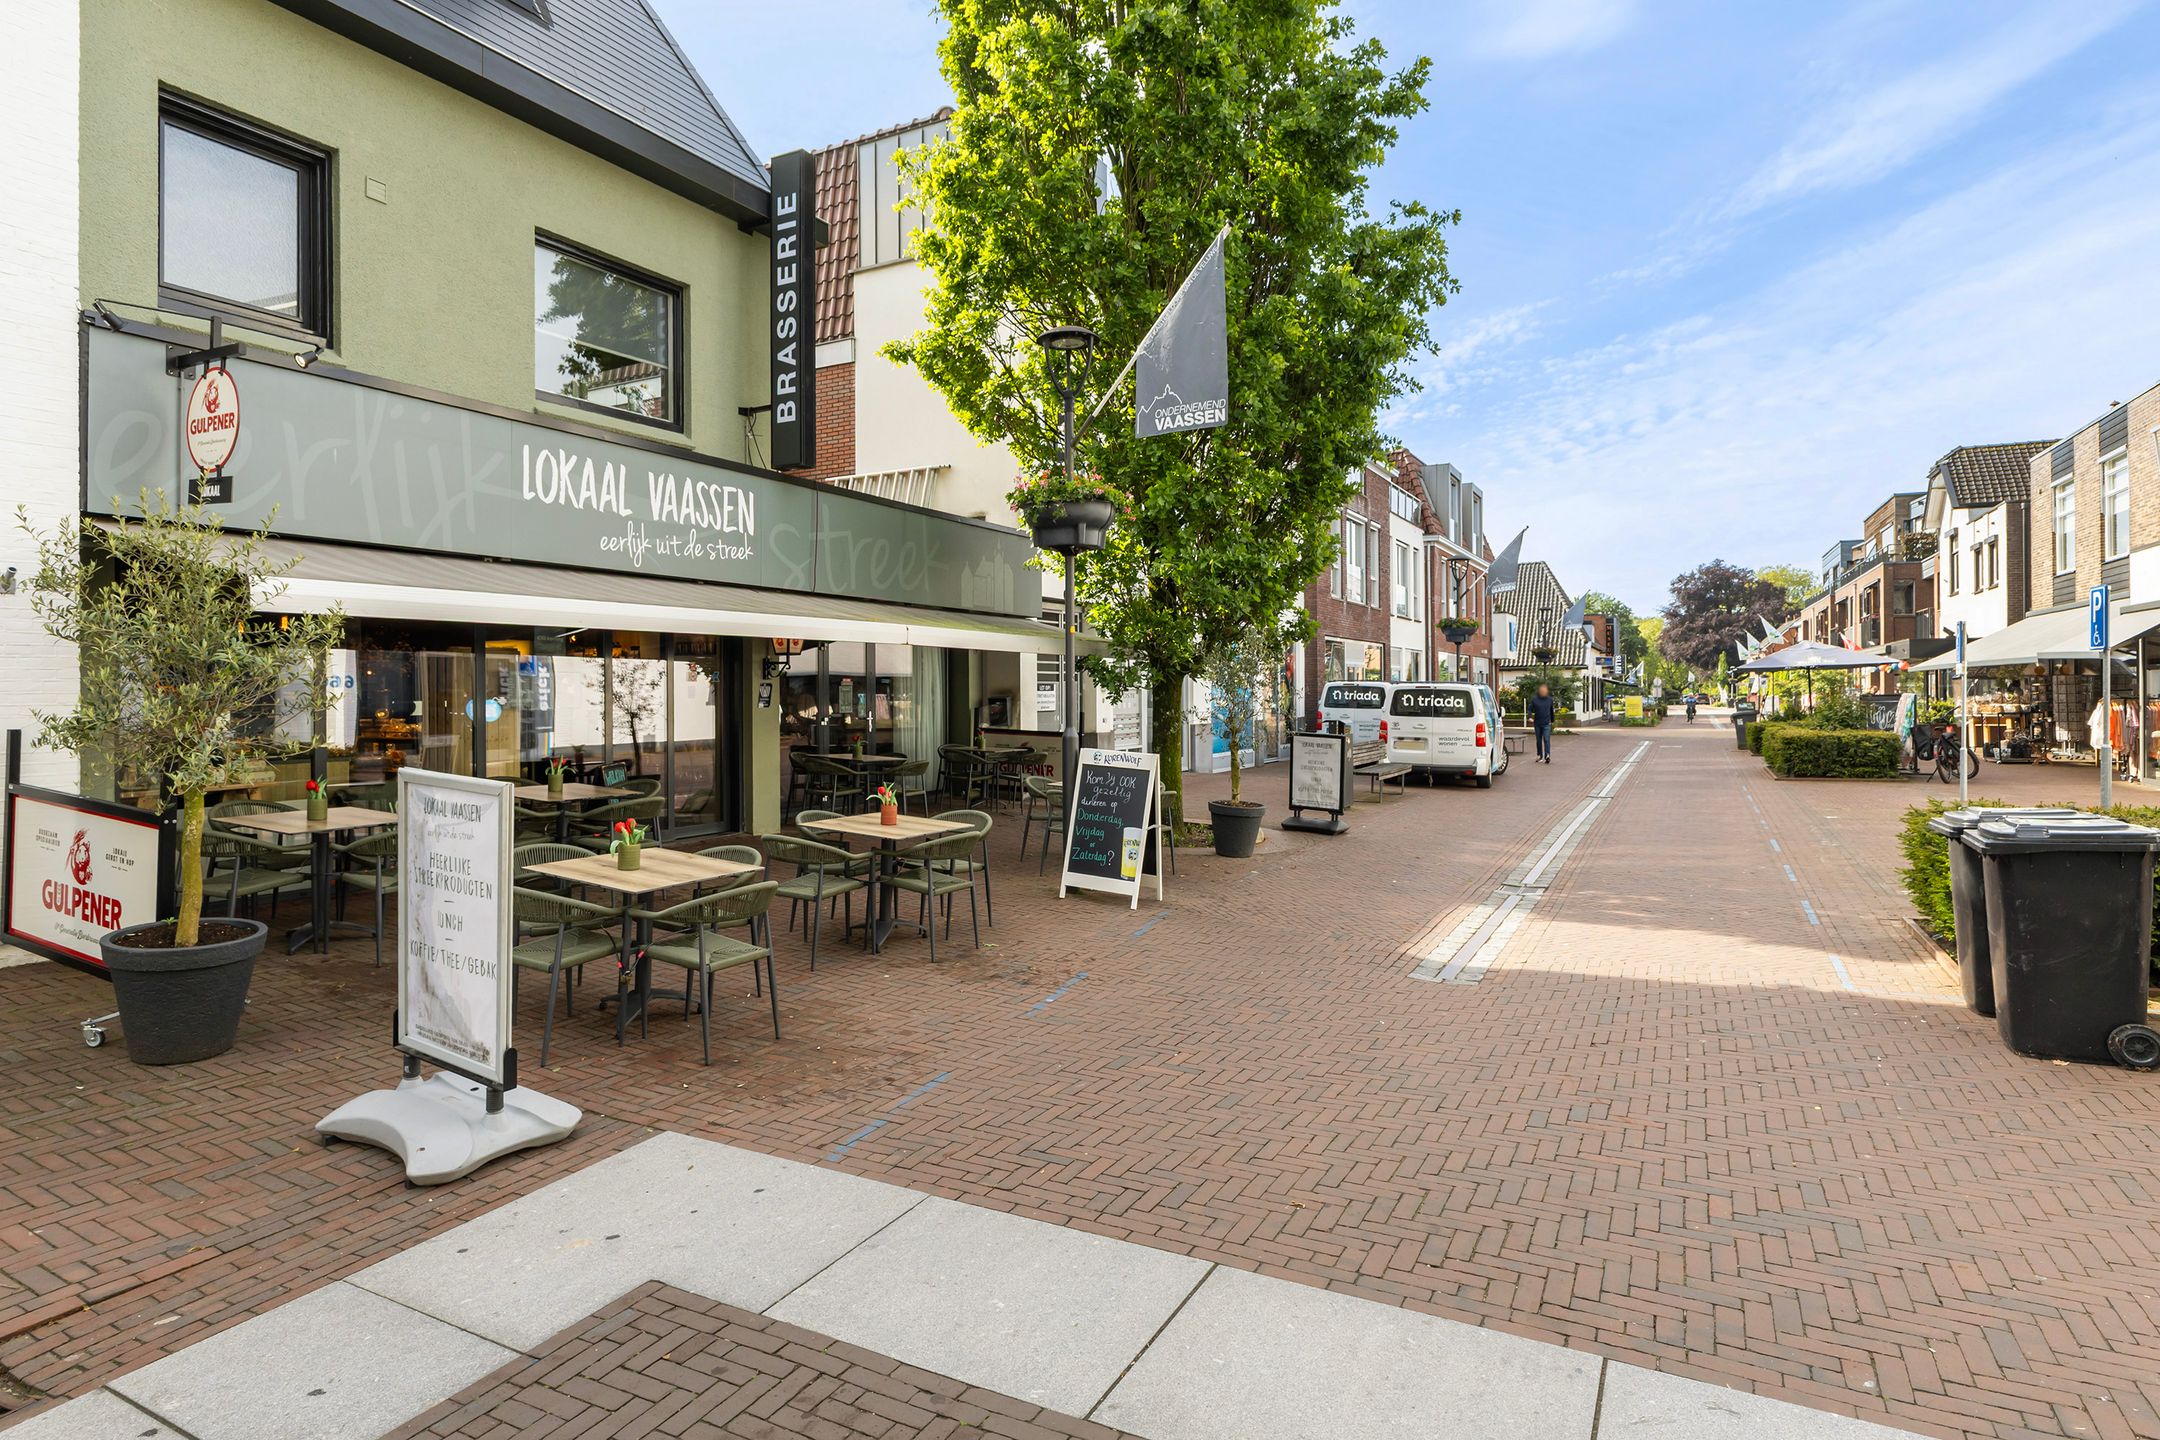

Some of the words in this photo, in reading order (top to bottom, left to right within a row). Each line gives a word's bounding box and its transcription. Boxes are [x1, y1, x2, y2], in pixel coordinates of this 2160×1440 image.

[776, 191, 797, 425] BRASSERIE
[1154, 398, 1226, 418] ONDERNEMEND
[1154, 408, 1226, 431] VAASSEN
[190, 411, 235, 435] GULPENER
[522, 444, 633, 518] LOKAAL
[648, 471, 755, 536] VAASSEN
[599, 520, 652, 568] eerlijk
[656, 535, 683, 558] uit
[683, 528, 704, 560] de
[706, 532, 754, 561] streek
[768, 503, 949, 595] streek
[2092, 591, 2102, 623] P
[1343, 690, 1380, 701] triada
[1417, 694, 1465, 708] triada
[1086, 769, 1104, 785] Kom
[1091, 785, 1132, 804] gezellig
[423, 796, 448, 818] LOKAAL
[450, 801, 482, 823] VAASSEN
[1110, 801, 1118, 814] op
[1075, 825, 1105, 841] Vrijdag
[429, 851, 471, 876] HEERLIJKE
[414, 866, 493, 900] STREEKPRODUCTEN
[42, 879, 122, 931] GULPENER
